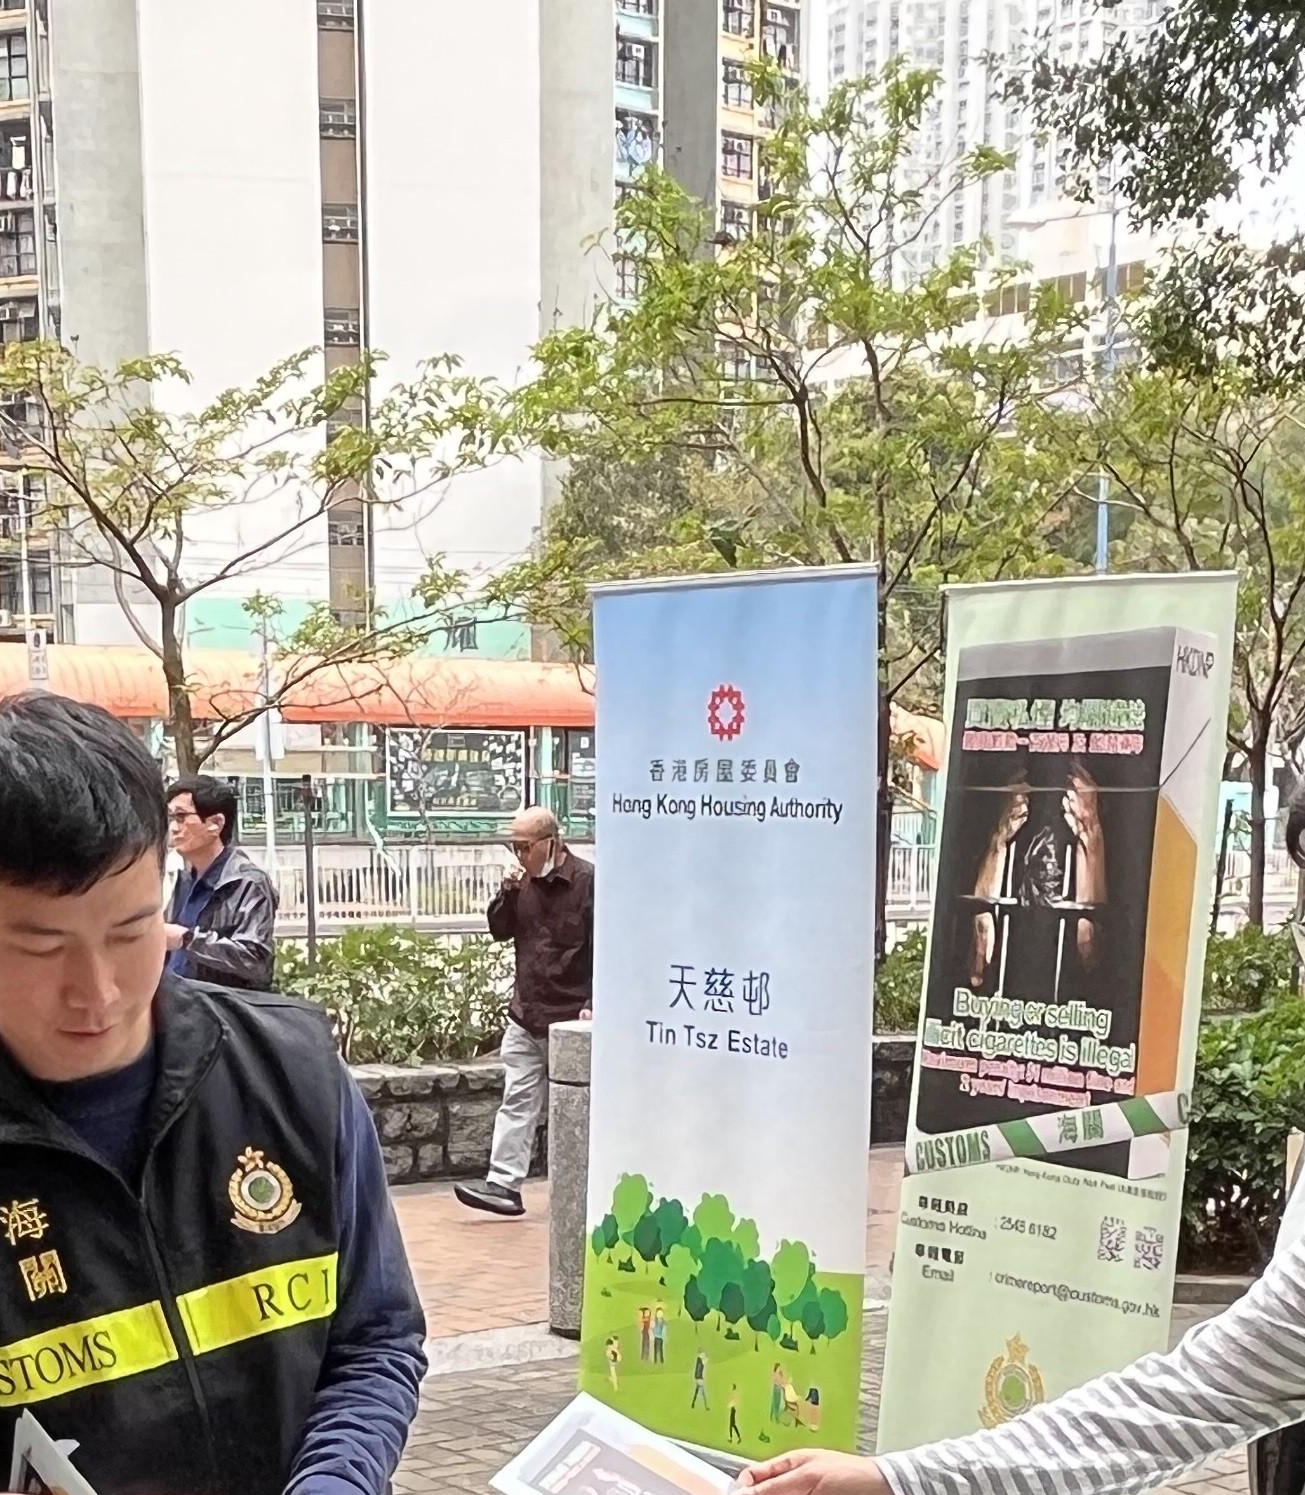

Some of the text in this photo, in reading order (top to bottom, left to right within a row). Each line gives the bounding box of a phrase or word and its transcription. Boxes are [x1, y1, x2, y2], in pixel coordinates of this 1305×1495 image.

[649, 757, 801, 784] 香港房屋委員會
[612, 793, 844, 825] Hong Kong Housing Authority
[669, 964, 770, 1016] 天慈邨
[645, 1020, 789, 1059] Tin Tsz Estate
[915, 1129, 991, 1172] CUSTOMS
